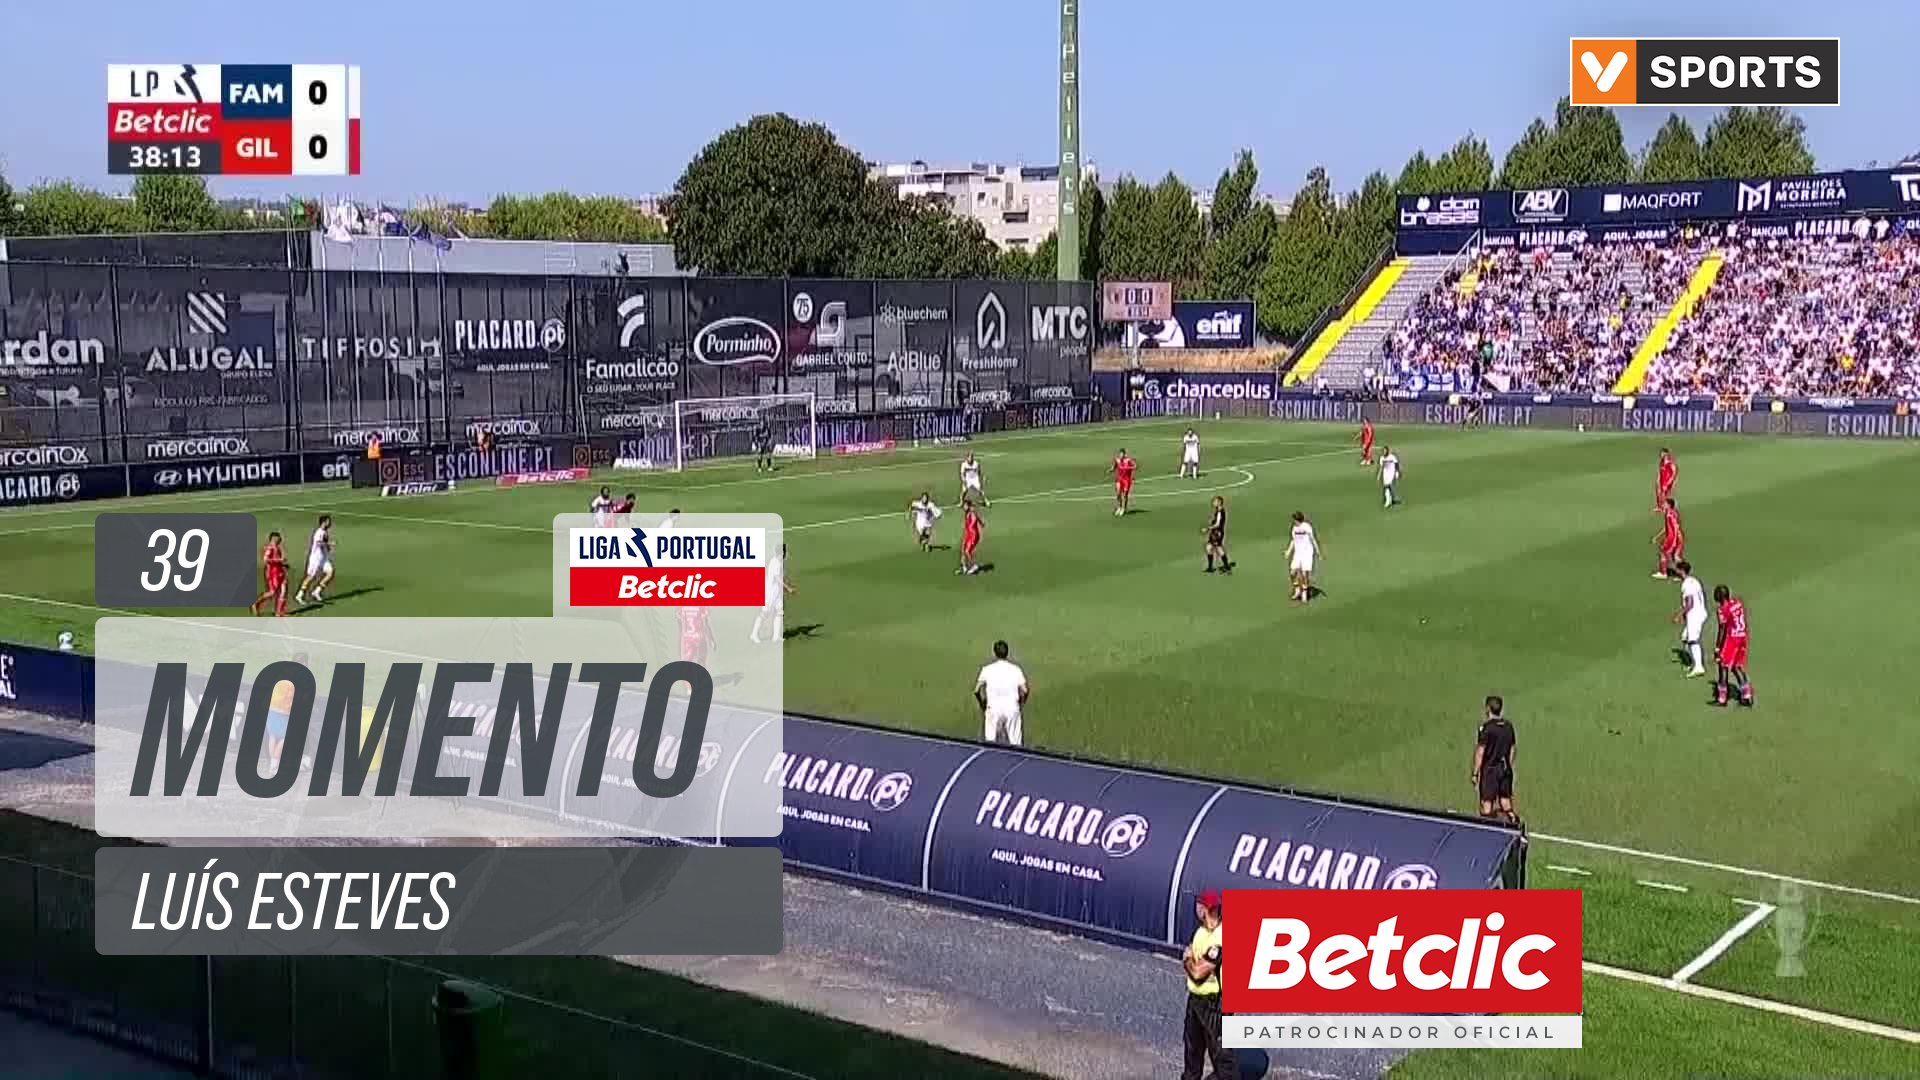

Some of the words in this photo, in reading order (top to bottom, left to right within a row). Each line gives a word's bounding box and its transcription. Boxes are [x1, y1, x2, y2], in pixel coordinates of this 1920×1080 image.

[1439, 196, 1480, 210] dom
[1519, 189, 1563, 211] ABV
[1622, 191, 1703, 210] MAQFORT
[1775, 187, 1847, 202] MOREIRA
[1400, 208, 1479, 226] brasas
[897, 299, 949, 321] bluechem
[1031, 305, 1088, 342] MTC
[0, 331, 104, 364] rdan
[145, 346, 273, 372] ALUGAL
[586, 357, 679, 380] Famalicão
[795, 353, 836, 366] GABRIEL
[962, 356, 1019, 370] FreshHome
[1166, 378, 1270, 400] chanceplus
[1622, 408, 1745, 433] ESCONLINE.PT
[186, 461, 281, 486] HYUNDAI
